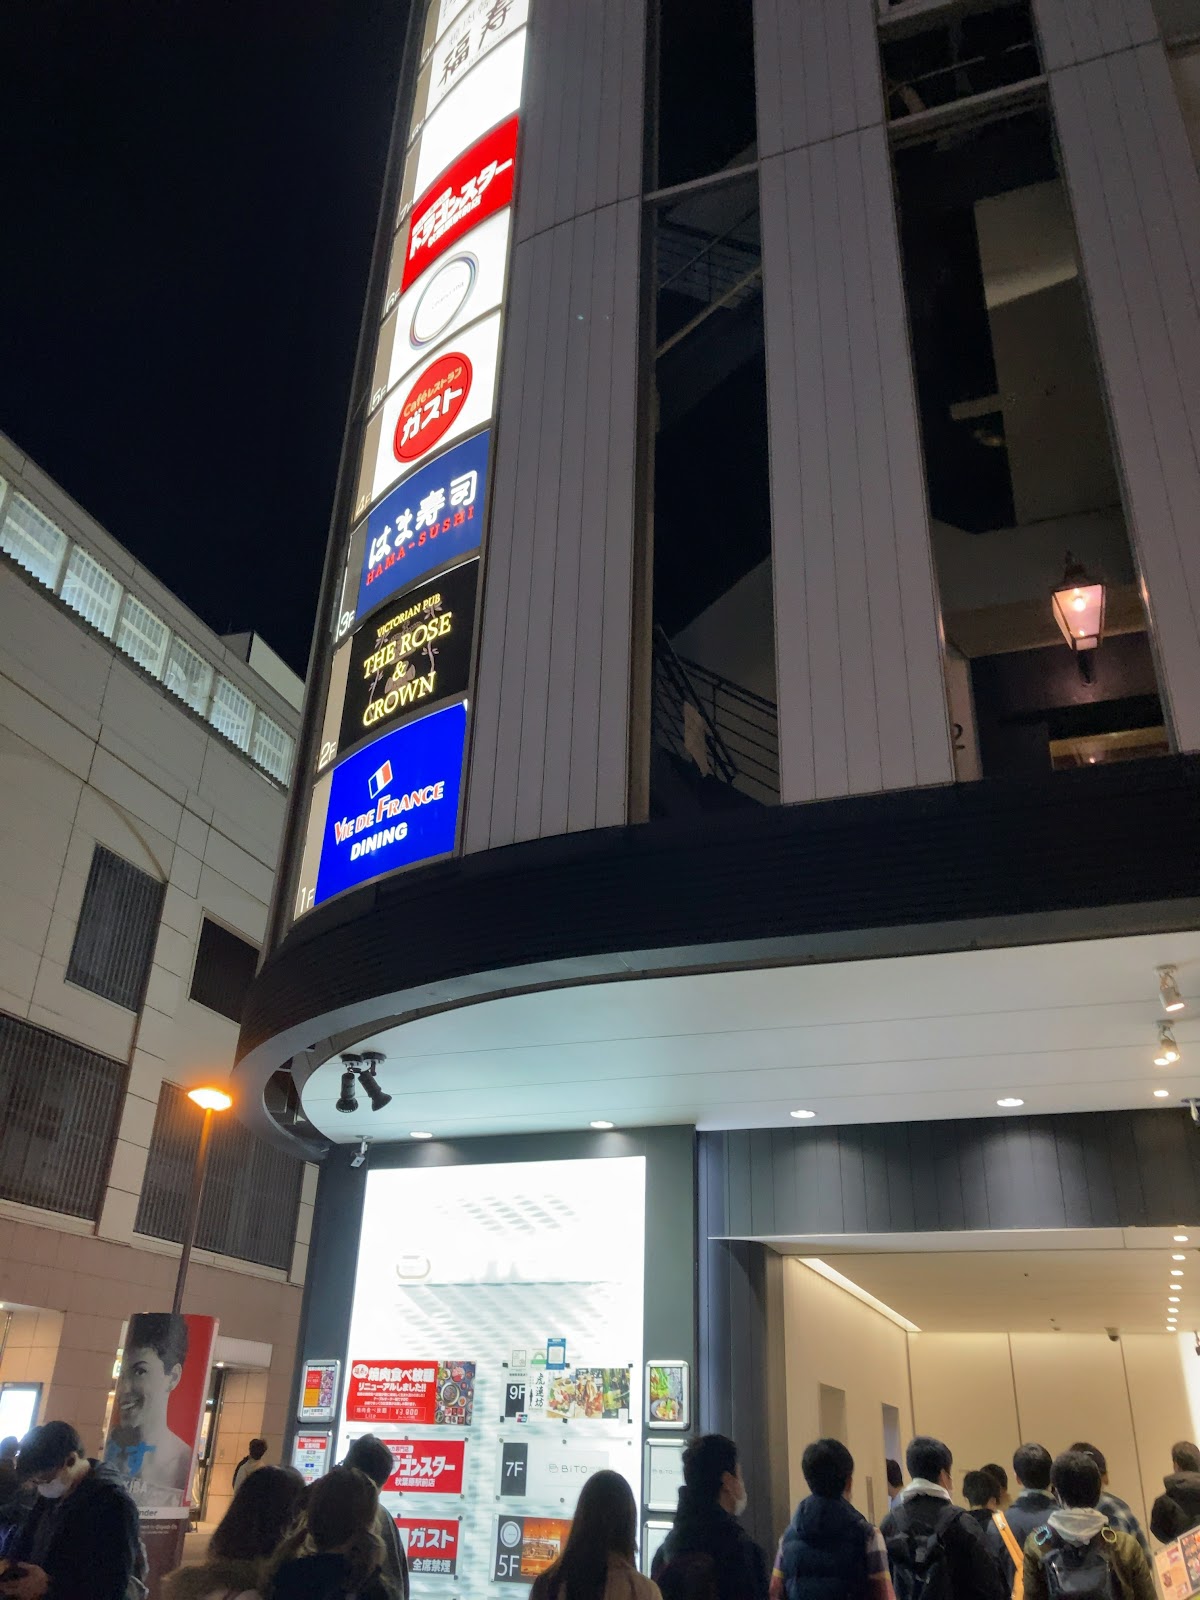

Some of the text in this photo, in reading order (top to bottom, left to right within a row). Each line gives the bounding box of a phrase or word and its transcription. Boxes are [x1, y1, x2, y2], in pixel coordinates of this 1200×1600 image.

[371, 385, 387, 412] 5F
[400, 386, 463, 448] ガスト
[368, 470, 478, 570] はま寿司
[366, 504, 475, 587] HAMA-SUSHI
[339, 609, 355, 637] 3F
[376, 592, 442, 638] VICTORIAN PUB
[363, 611, 453, 680] THE ROSE
[391, 660, 408, 682] &
[362, 671, 437, 727] CROWN
[318, 741, 337, 770] 2F
[355, 808, 376, 834] DE
[375, 781, 446, 824] FRANCE
[350, 822, 408, 862] DINING
[300, 887, 315, 914] 1F
[509, 1385, 526, 1400] 9F
[505, 1461, 525, 1477] 7F
[409, 1527, 455, 1549] ガスト
[412, 1558, 451, 1573] 全席禁煙
[497, 1554, 520, 1577] 5F
